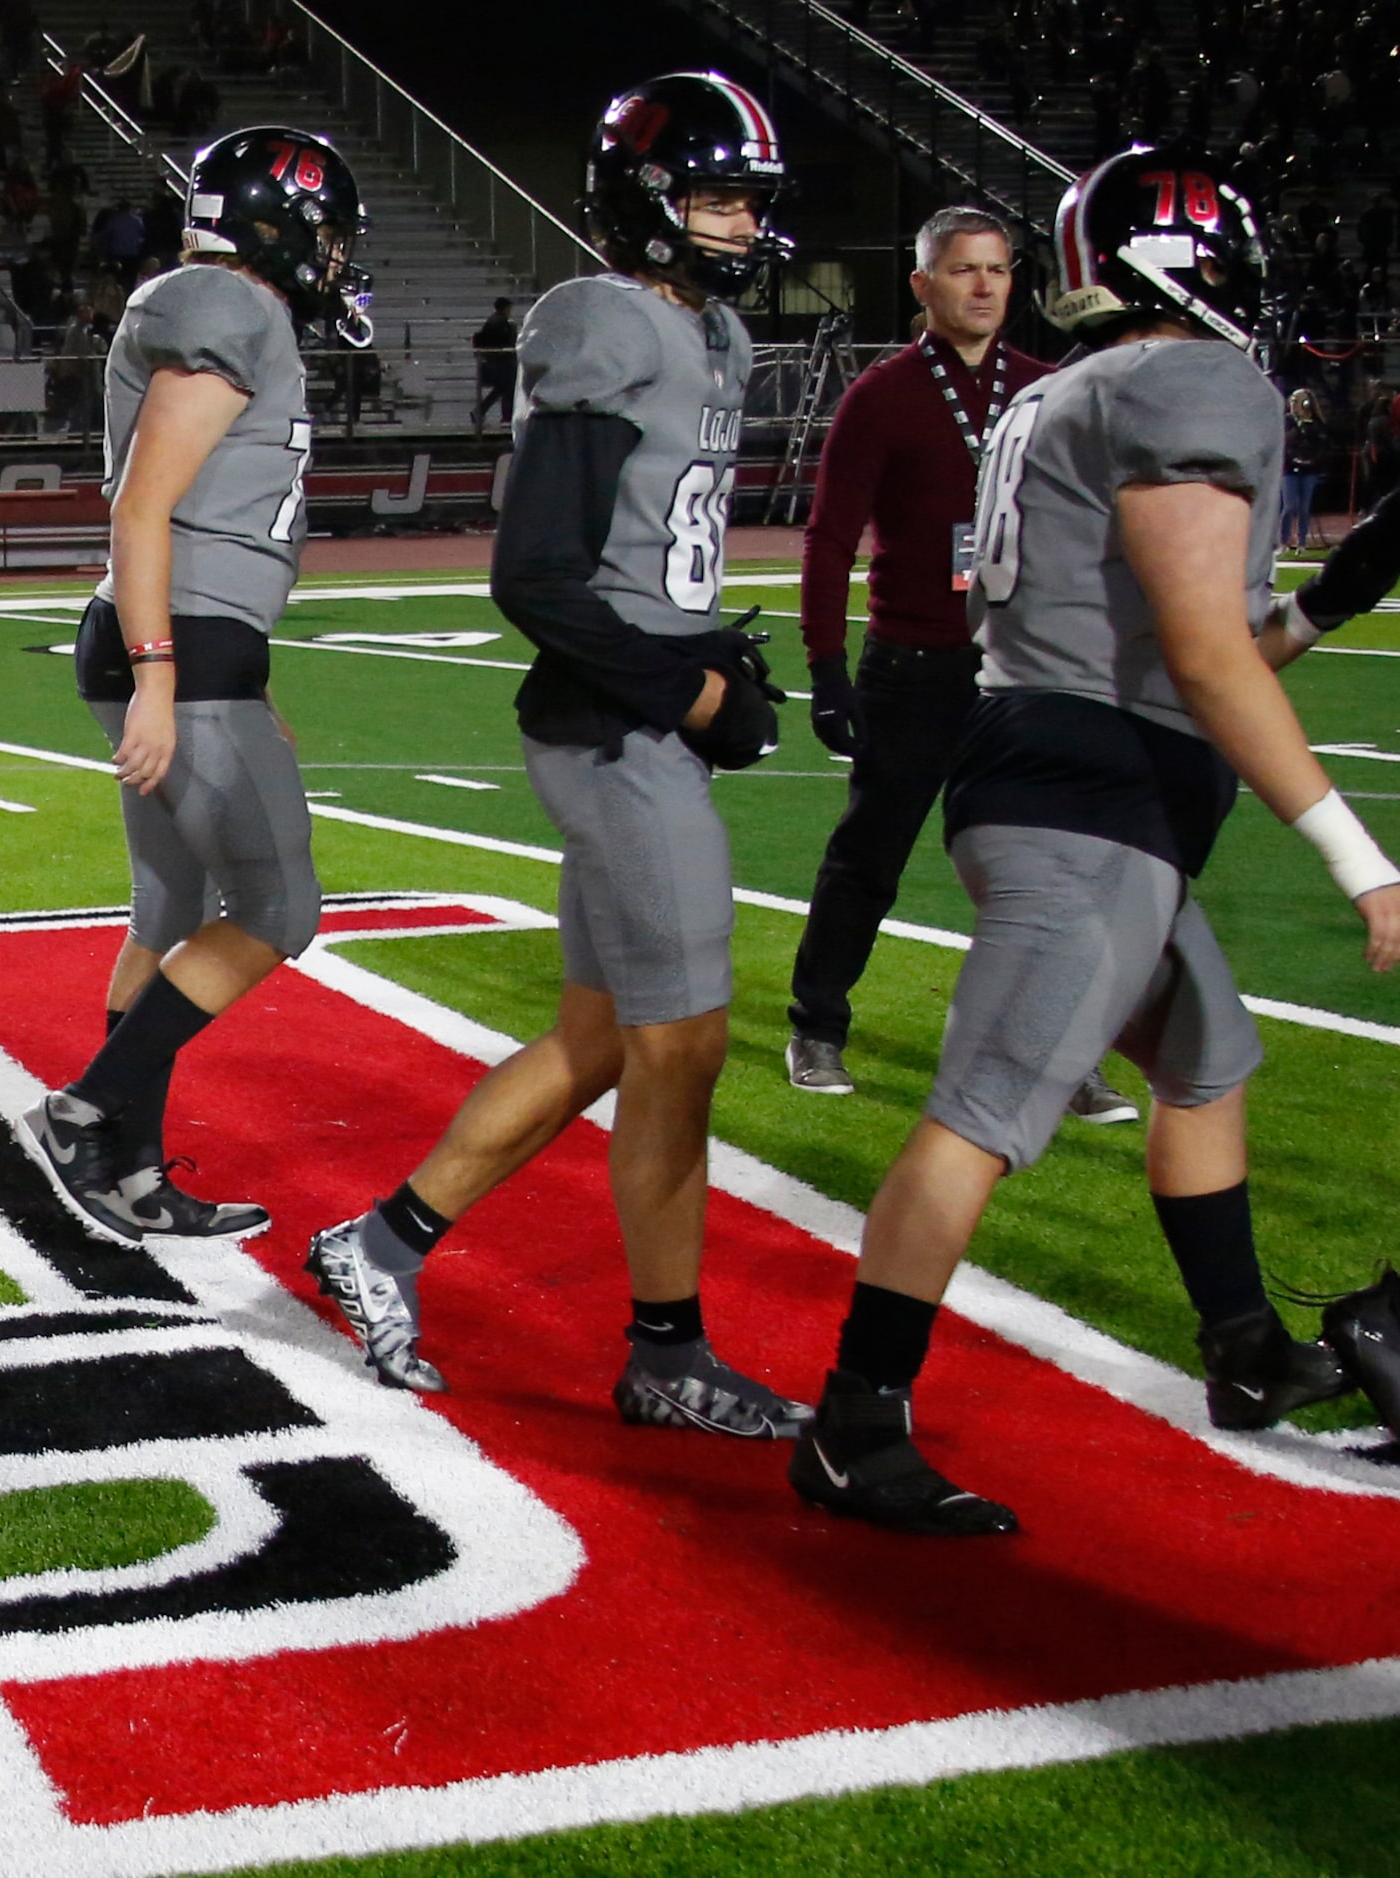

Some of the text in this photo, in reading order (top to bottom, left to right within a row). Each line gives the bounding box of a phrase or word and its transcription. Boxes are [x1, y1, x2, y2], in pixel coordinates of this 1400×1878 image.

[268, 140, 326, 192] 76
[750, 159, 784, 174] Riddell
[1139, 171, 1219, 229] 78
[699, 406, 743, 453] LOJO
